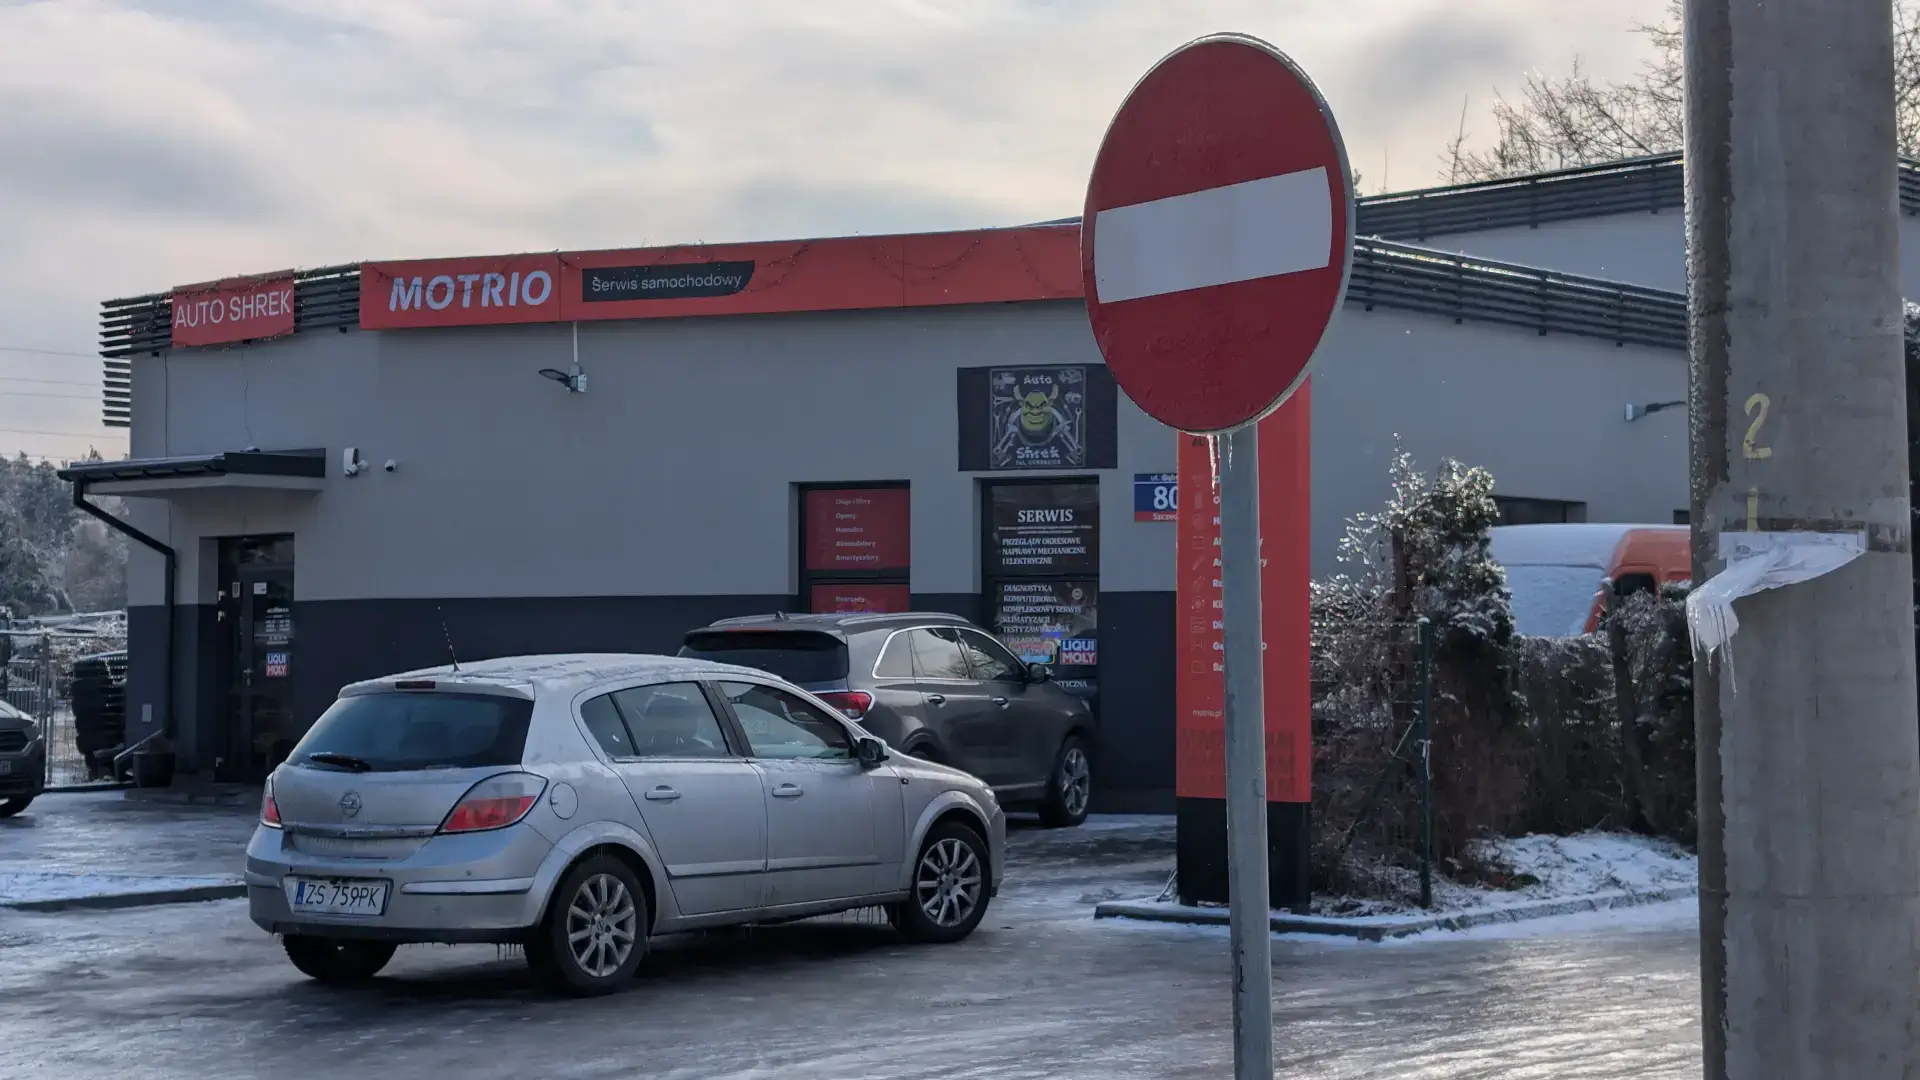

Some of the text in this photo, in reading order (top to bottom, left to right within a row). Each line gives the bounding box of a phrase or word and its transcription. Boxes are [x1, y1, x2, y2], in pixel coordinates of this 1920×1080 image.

[591, 273, 742, 292] Serwis samochodowy
[389, 270, 552, 312] MOTRIO
[174, 289, 292, 329] AUTO SHREK
[1023, 375, 1053, 385] Auto
[1743, 392, 1772, 460] 2
[1016, 446, 1061, 460] Shrek
[1018, 509, 1074, 523] SERWIS
[1002, 537, 1081, 547] PRZEGLĄDY OKRESOWE
[1002, 546, 1087, 556] NAPRAWY MECHANICZNE
[1006, 557, 1053, 565] ELEKTRYCZNE
[1003, 585, 1053, 593] DIAGNOSTYKA
[1003, 595, 1057, 603] KOMPUTEROWA
[1002, 605, 1082, 613] KOMPLEKSOWY SERWIS
[1002, 616, 1051, 624] KLIMATYZACJI
[1062, 640, 1095, 651] LIQUI
[267, 653, 287, 665] LIQUI
[1062, 652, 1095, 663] MOLY
[267, 665, 287, 676] MOLY
[304, 884, 381, 908] ZS 759PK
